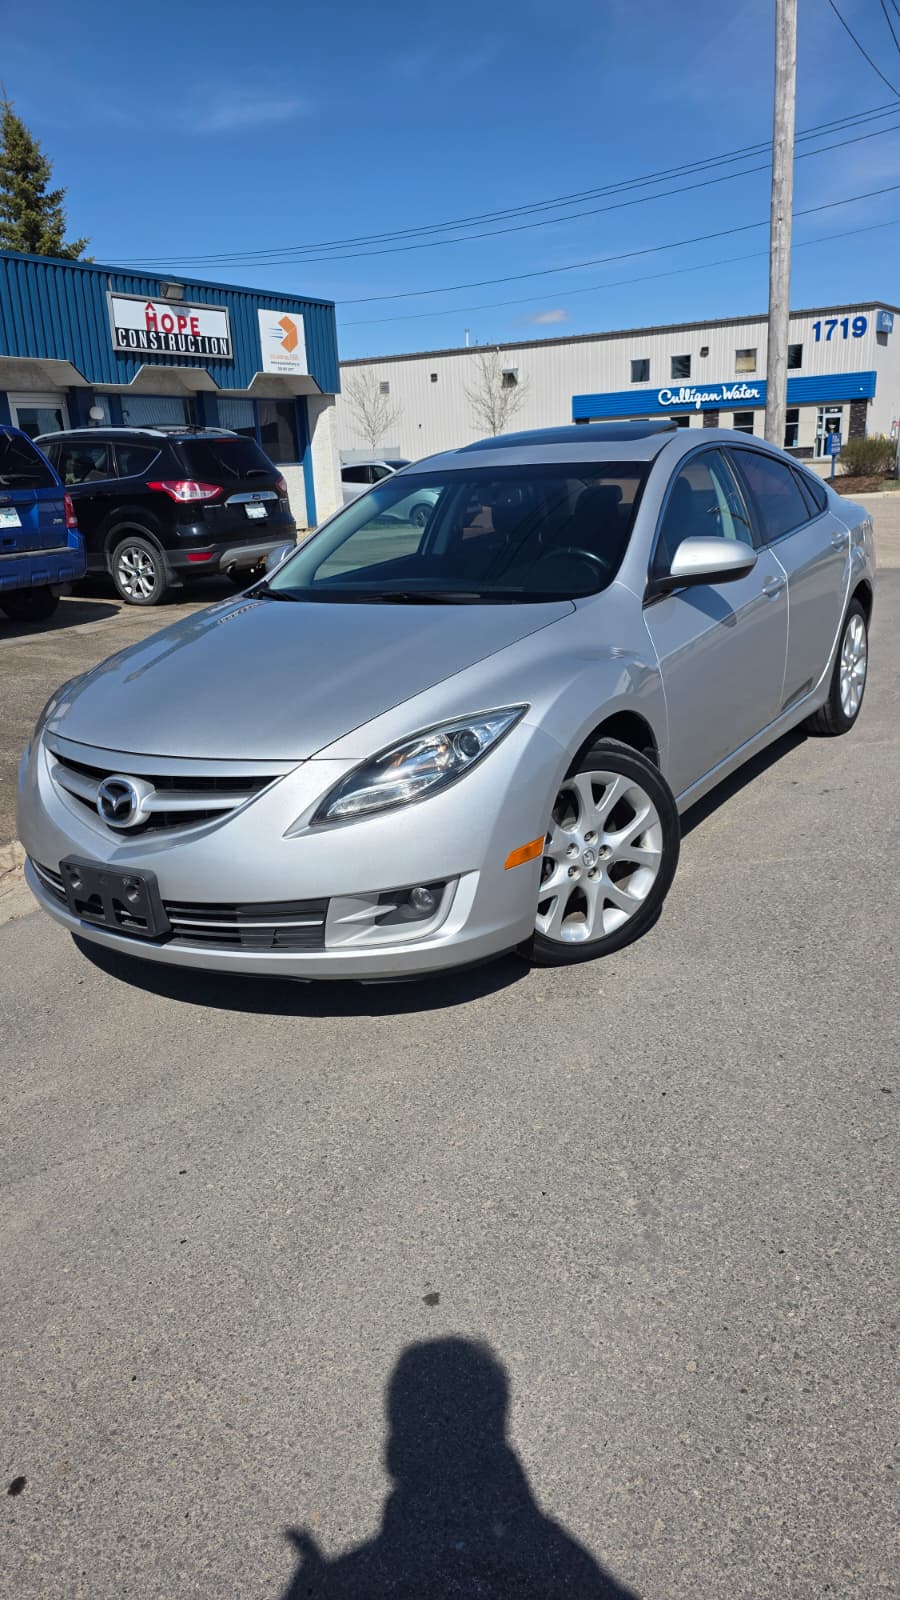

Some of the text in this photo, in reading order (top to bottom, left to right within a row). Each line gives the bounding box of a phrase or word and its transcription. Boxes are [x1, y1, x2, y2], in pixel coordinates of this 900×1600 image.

[145, 311, 201, 336] HOPE
[812, 316, 867, 342] 1719
[118, 328, 229, 355] CONSTRUCTION
[658, 383, 760, 409] Culligan Water
